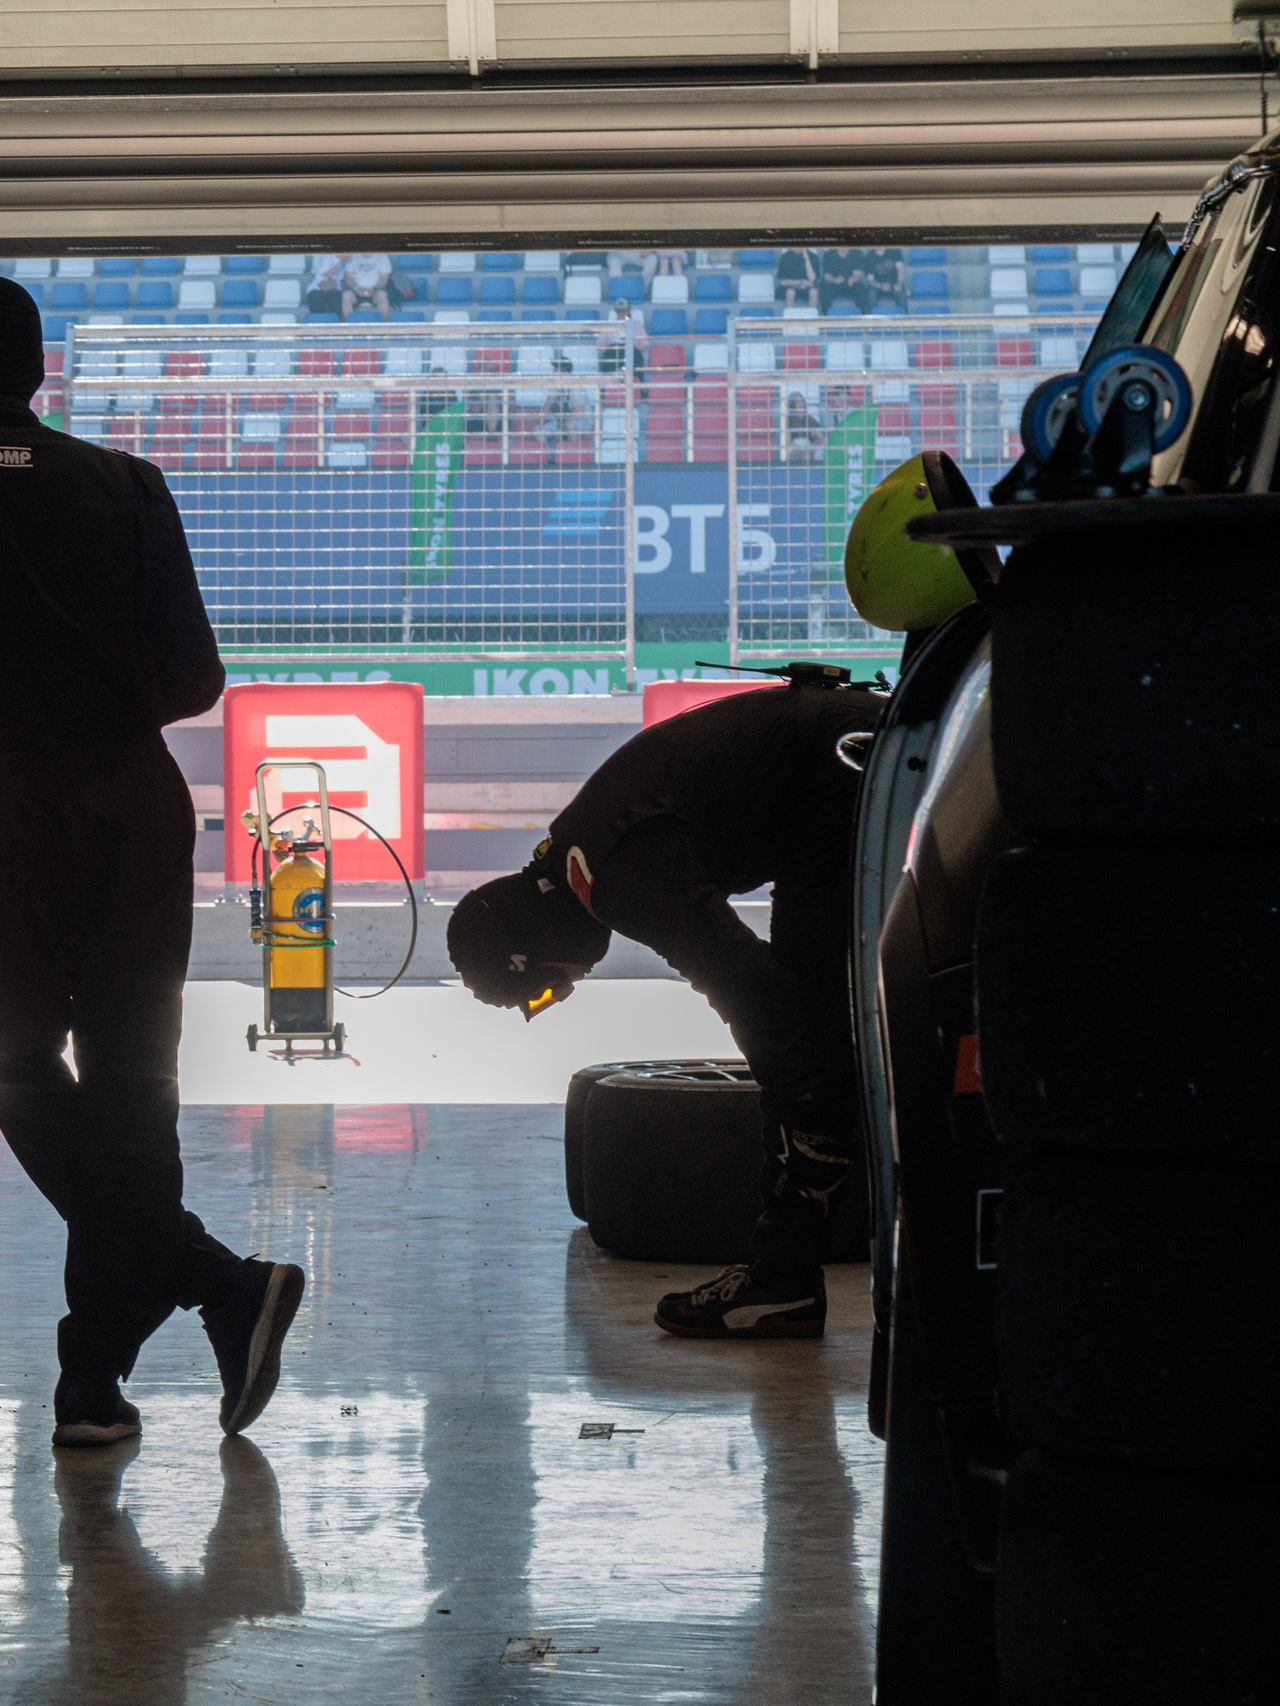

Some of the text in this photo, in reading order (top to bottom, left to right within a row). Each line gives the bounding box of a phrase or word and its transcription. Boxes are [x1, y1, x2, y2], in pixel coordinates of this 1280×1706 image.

[433, 441, 451, 510] TYRES
[847, 443, 864, 515] TYRES
[631, 504, 778, 574] ВТБ
[473, 668, 610, 695] IKON
